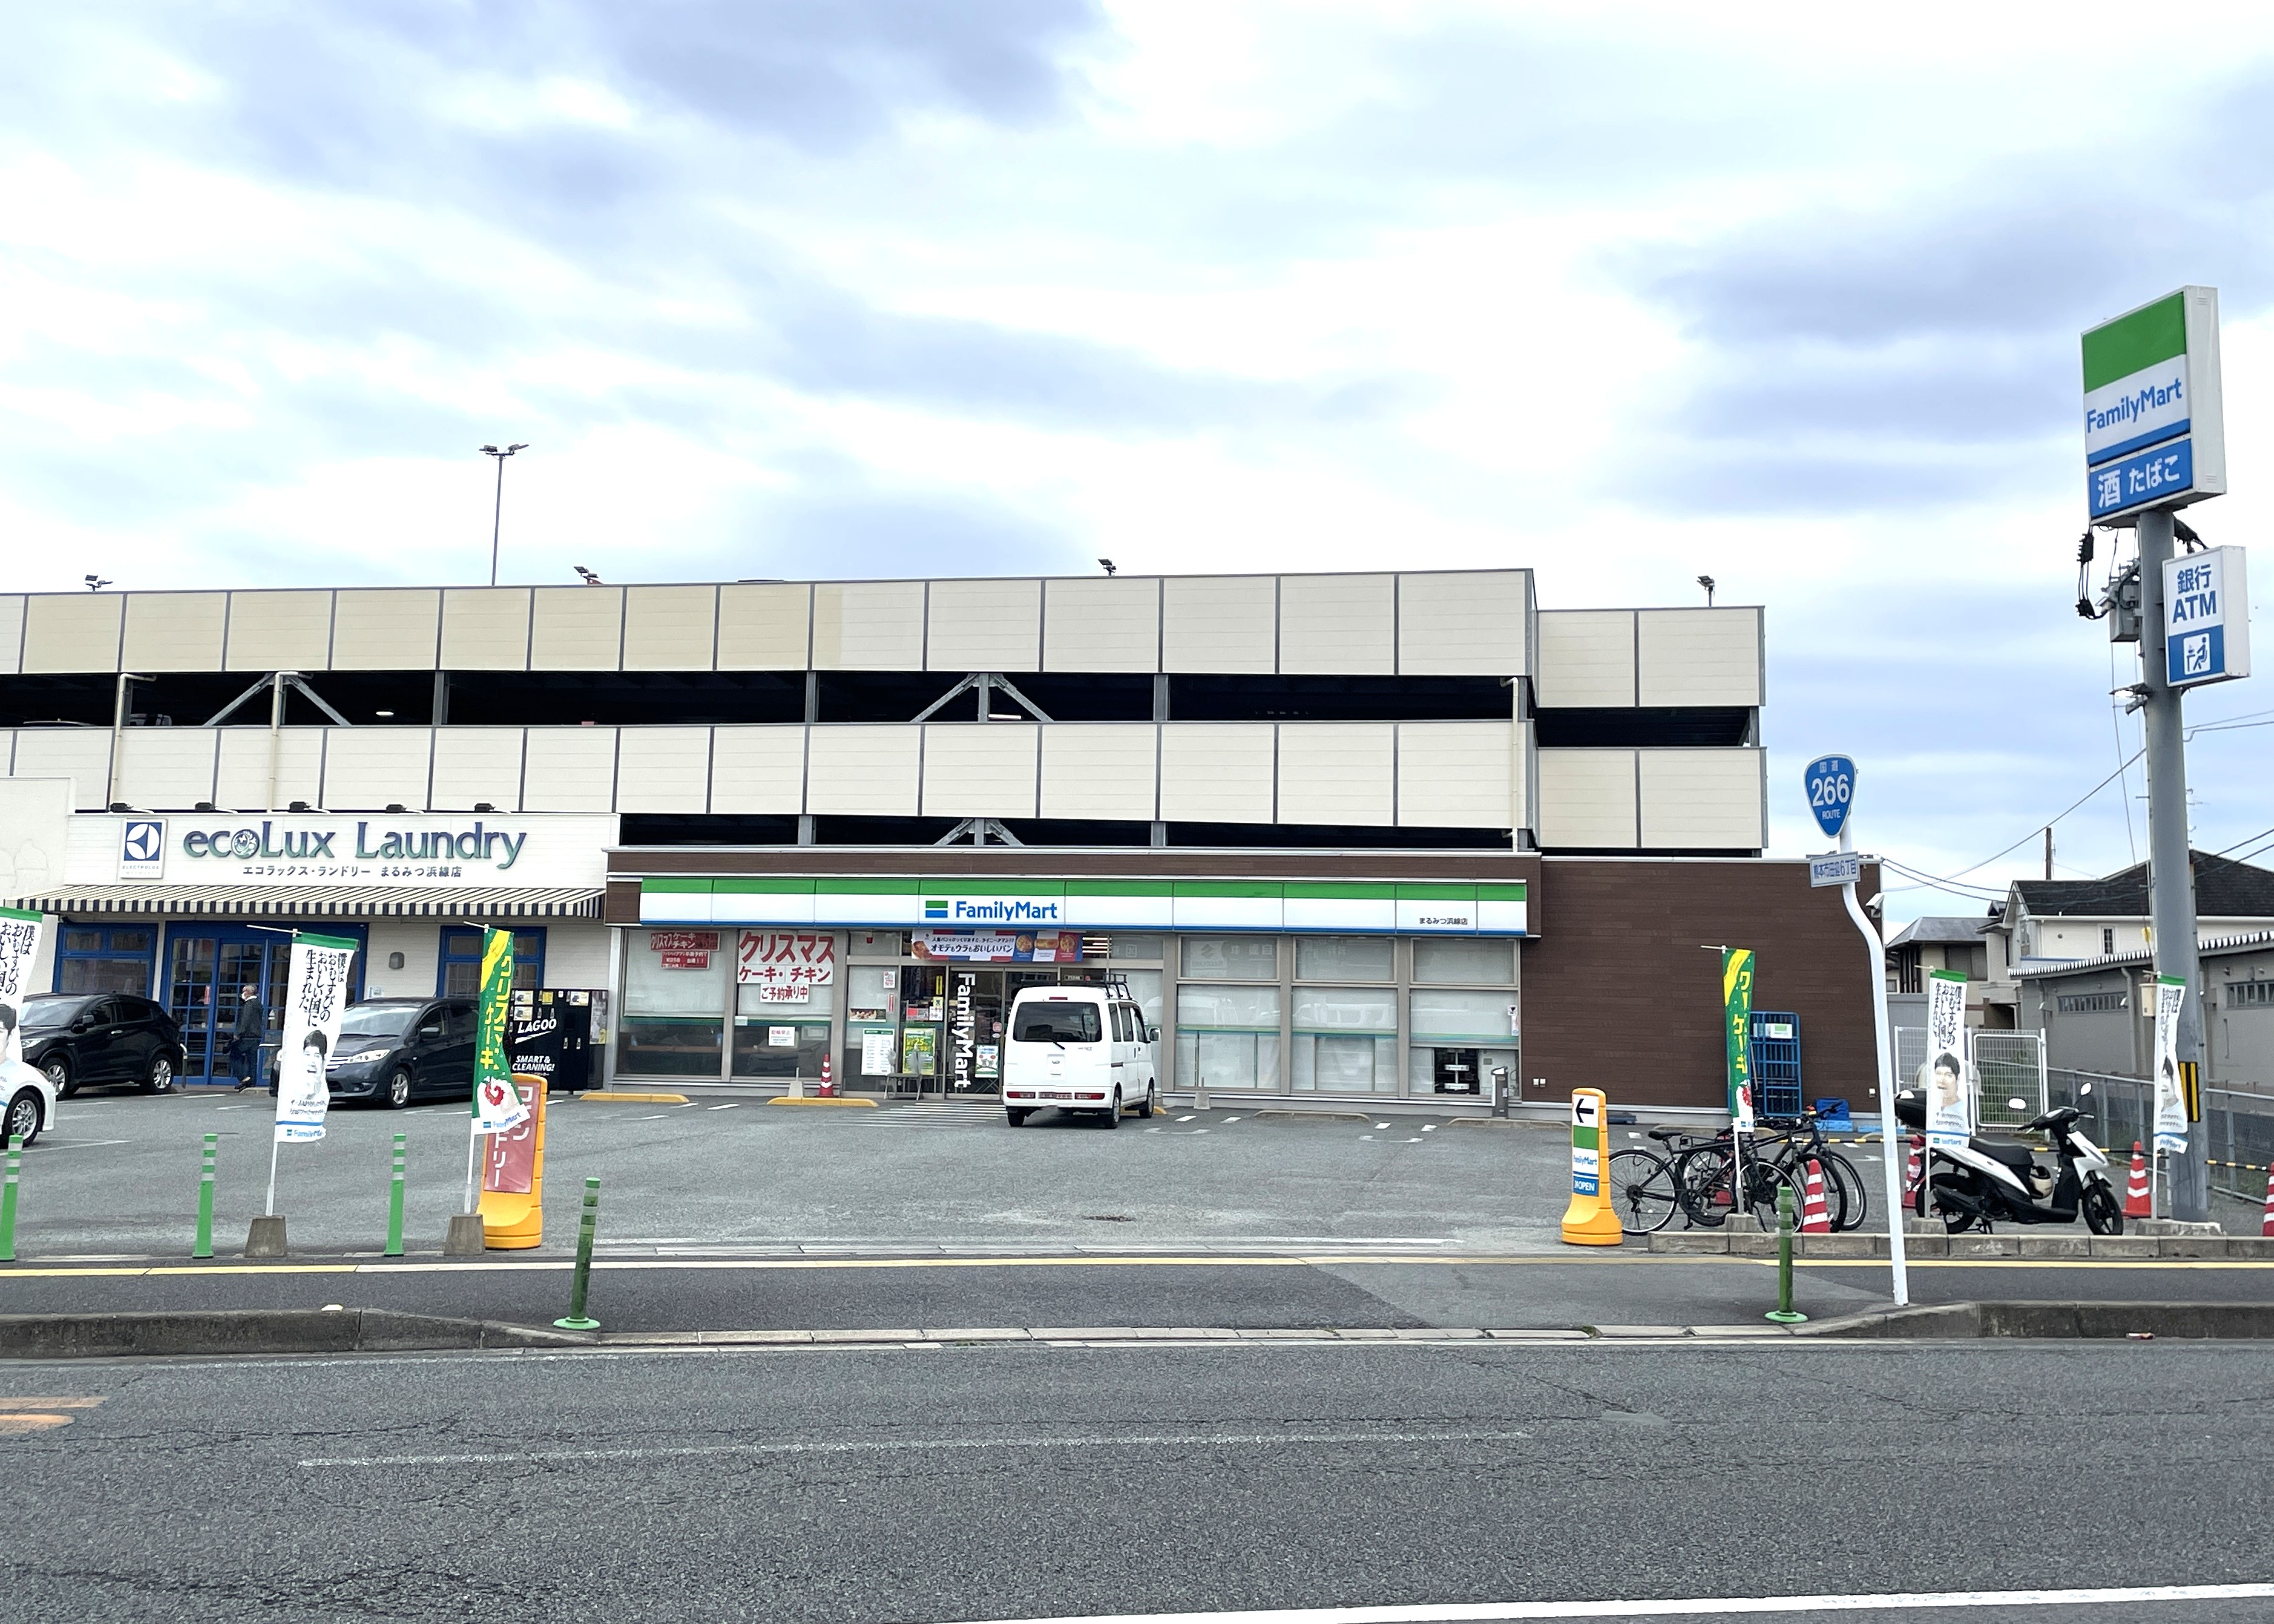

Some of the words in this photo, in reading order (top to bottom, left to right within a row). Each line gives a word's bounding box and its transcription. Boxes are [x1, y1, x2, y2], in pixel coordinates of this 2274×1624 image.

[2087, 378, 2182, 433] FamilyMart
[2098, 468, 2121, 509] 酒
[2129, 454, 2180, 495] たばこ
[2177, 564, 2212, 594] 銀行
[2172, 590, 2217, 624] ATM
[1819, 760, 1839, 774] 国道
[1811, 773, 1850, 807] 266
[1822, 809, 1841, 820] ROUTE
[183, 821, 336, 859] ecoLux
[355, 821, 527, 870] Laundry
[242, 865, 371, 877] エコラックス・ランドリー
[381, 865, 462, 877] まるみつ浜線店
[956, 900, 1058, 921] FamilyMart
[738, 931, 835, 964] クリスマス
[930, 943, 1013, 953] オモテもウラもおいしいパン
[761, 985, 808, 1000] ご予約承り中
[517, 1019, 557, 1034] LAGOO
[951, 973, 976, 1088] FamilyMart
